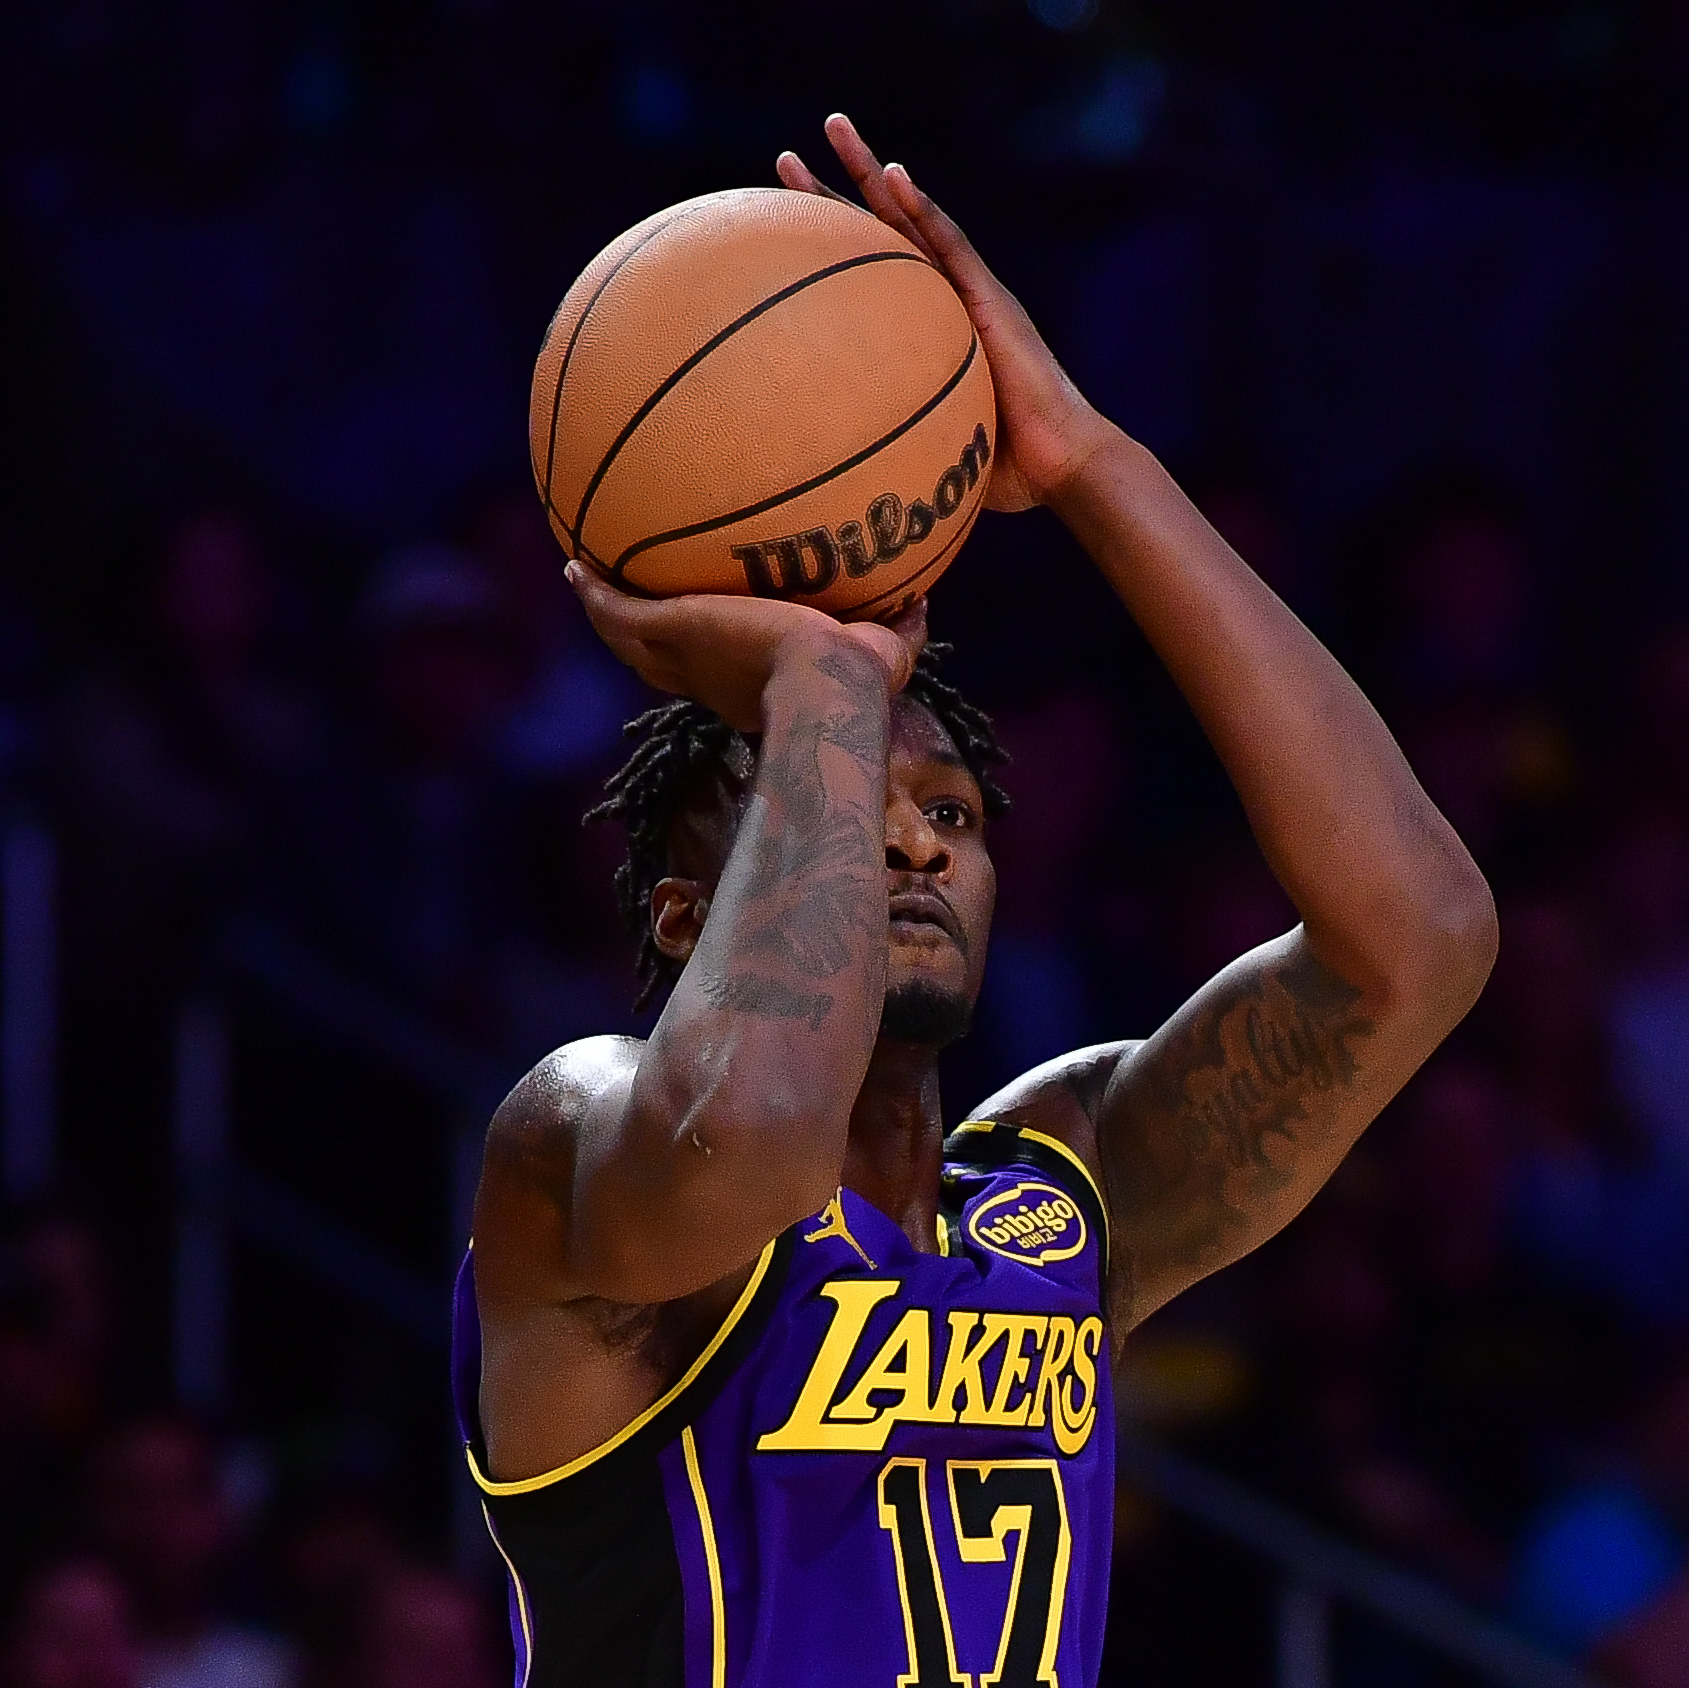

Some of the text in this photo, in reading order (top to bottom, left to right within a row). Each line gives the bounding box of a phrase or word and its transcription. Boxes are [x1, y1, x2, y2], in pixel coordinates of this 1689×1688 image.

[732, 422, 992, 598] Wilson
[979, 1199, 1074, 1245] bibigo
[755, 1279, 1103, 1455] LAKERS
